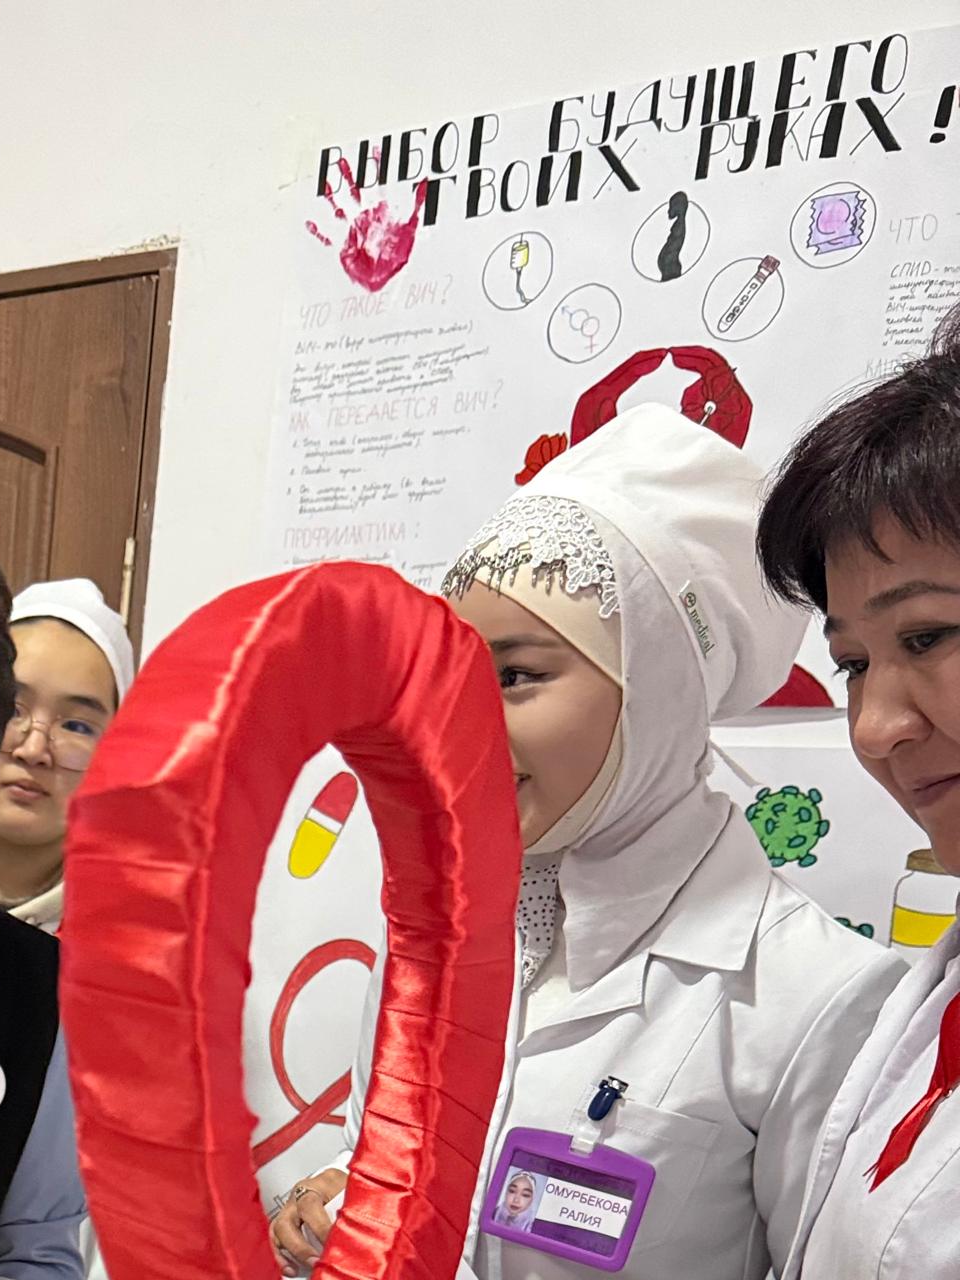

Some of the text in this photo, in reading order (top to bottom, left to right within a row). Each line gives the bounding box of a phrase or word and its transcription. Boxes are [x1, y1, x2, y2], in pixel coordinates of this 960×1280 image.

[317, 34, 908, 197] ВЫБОР БУДУЩЕГО
[411, 138, 641, 227] ТВОИХ
[889, 213, 939, 243] ЧТО
[300, 273, 454, 329] ЧТО ТАКОЕ ВИЧ?
[326, 396, 440, 428] ПЕРЕДАЕТСЯ
[453, 379, 504, 414] ВИЧ?
[689, 609, 716, 654] medical
[545, 1183, 628, 1217] ОМУРБЕКОВА
[559, 1207, 602, 1228] РАЛИЯ
